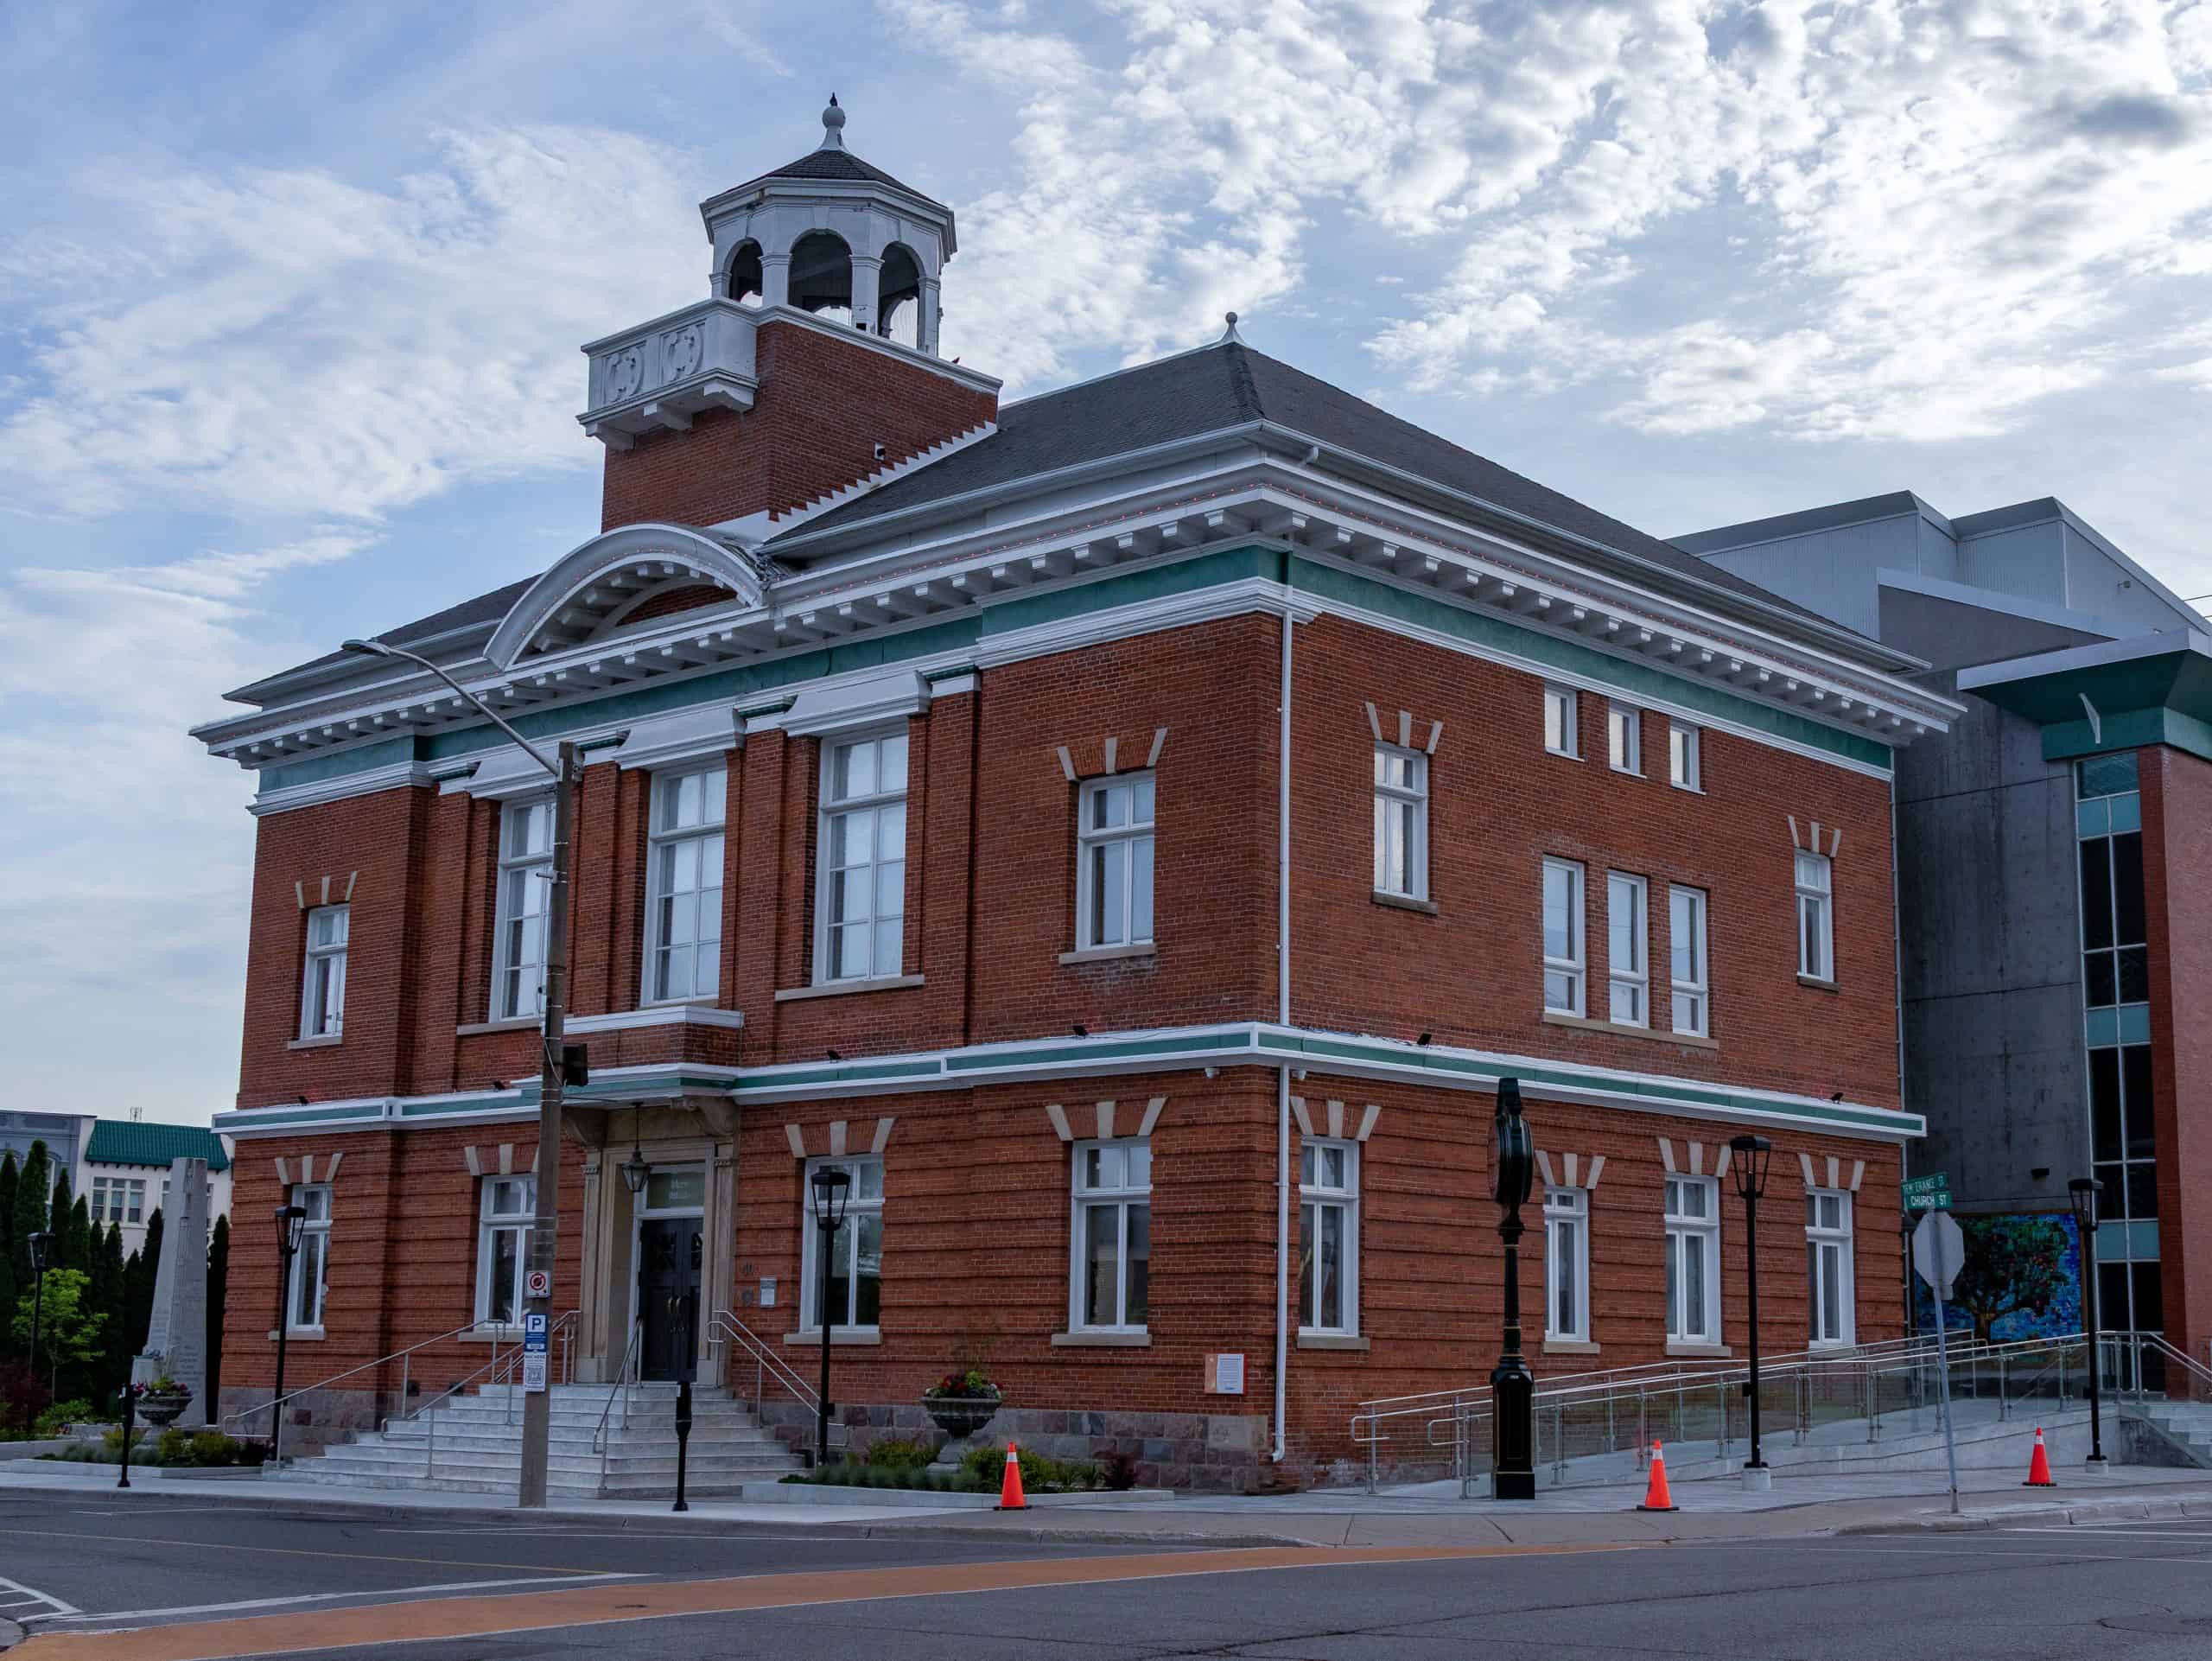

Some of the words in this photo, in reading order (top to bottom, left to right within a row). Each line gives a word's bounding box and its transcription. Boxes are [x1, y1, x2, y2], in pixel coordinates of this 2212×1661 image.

[1910, 1195, 1936, 1206] CHURCH
[1939, 1194, 1947, 1206] ST
[531, 1317, 542, 1330] P
